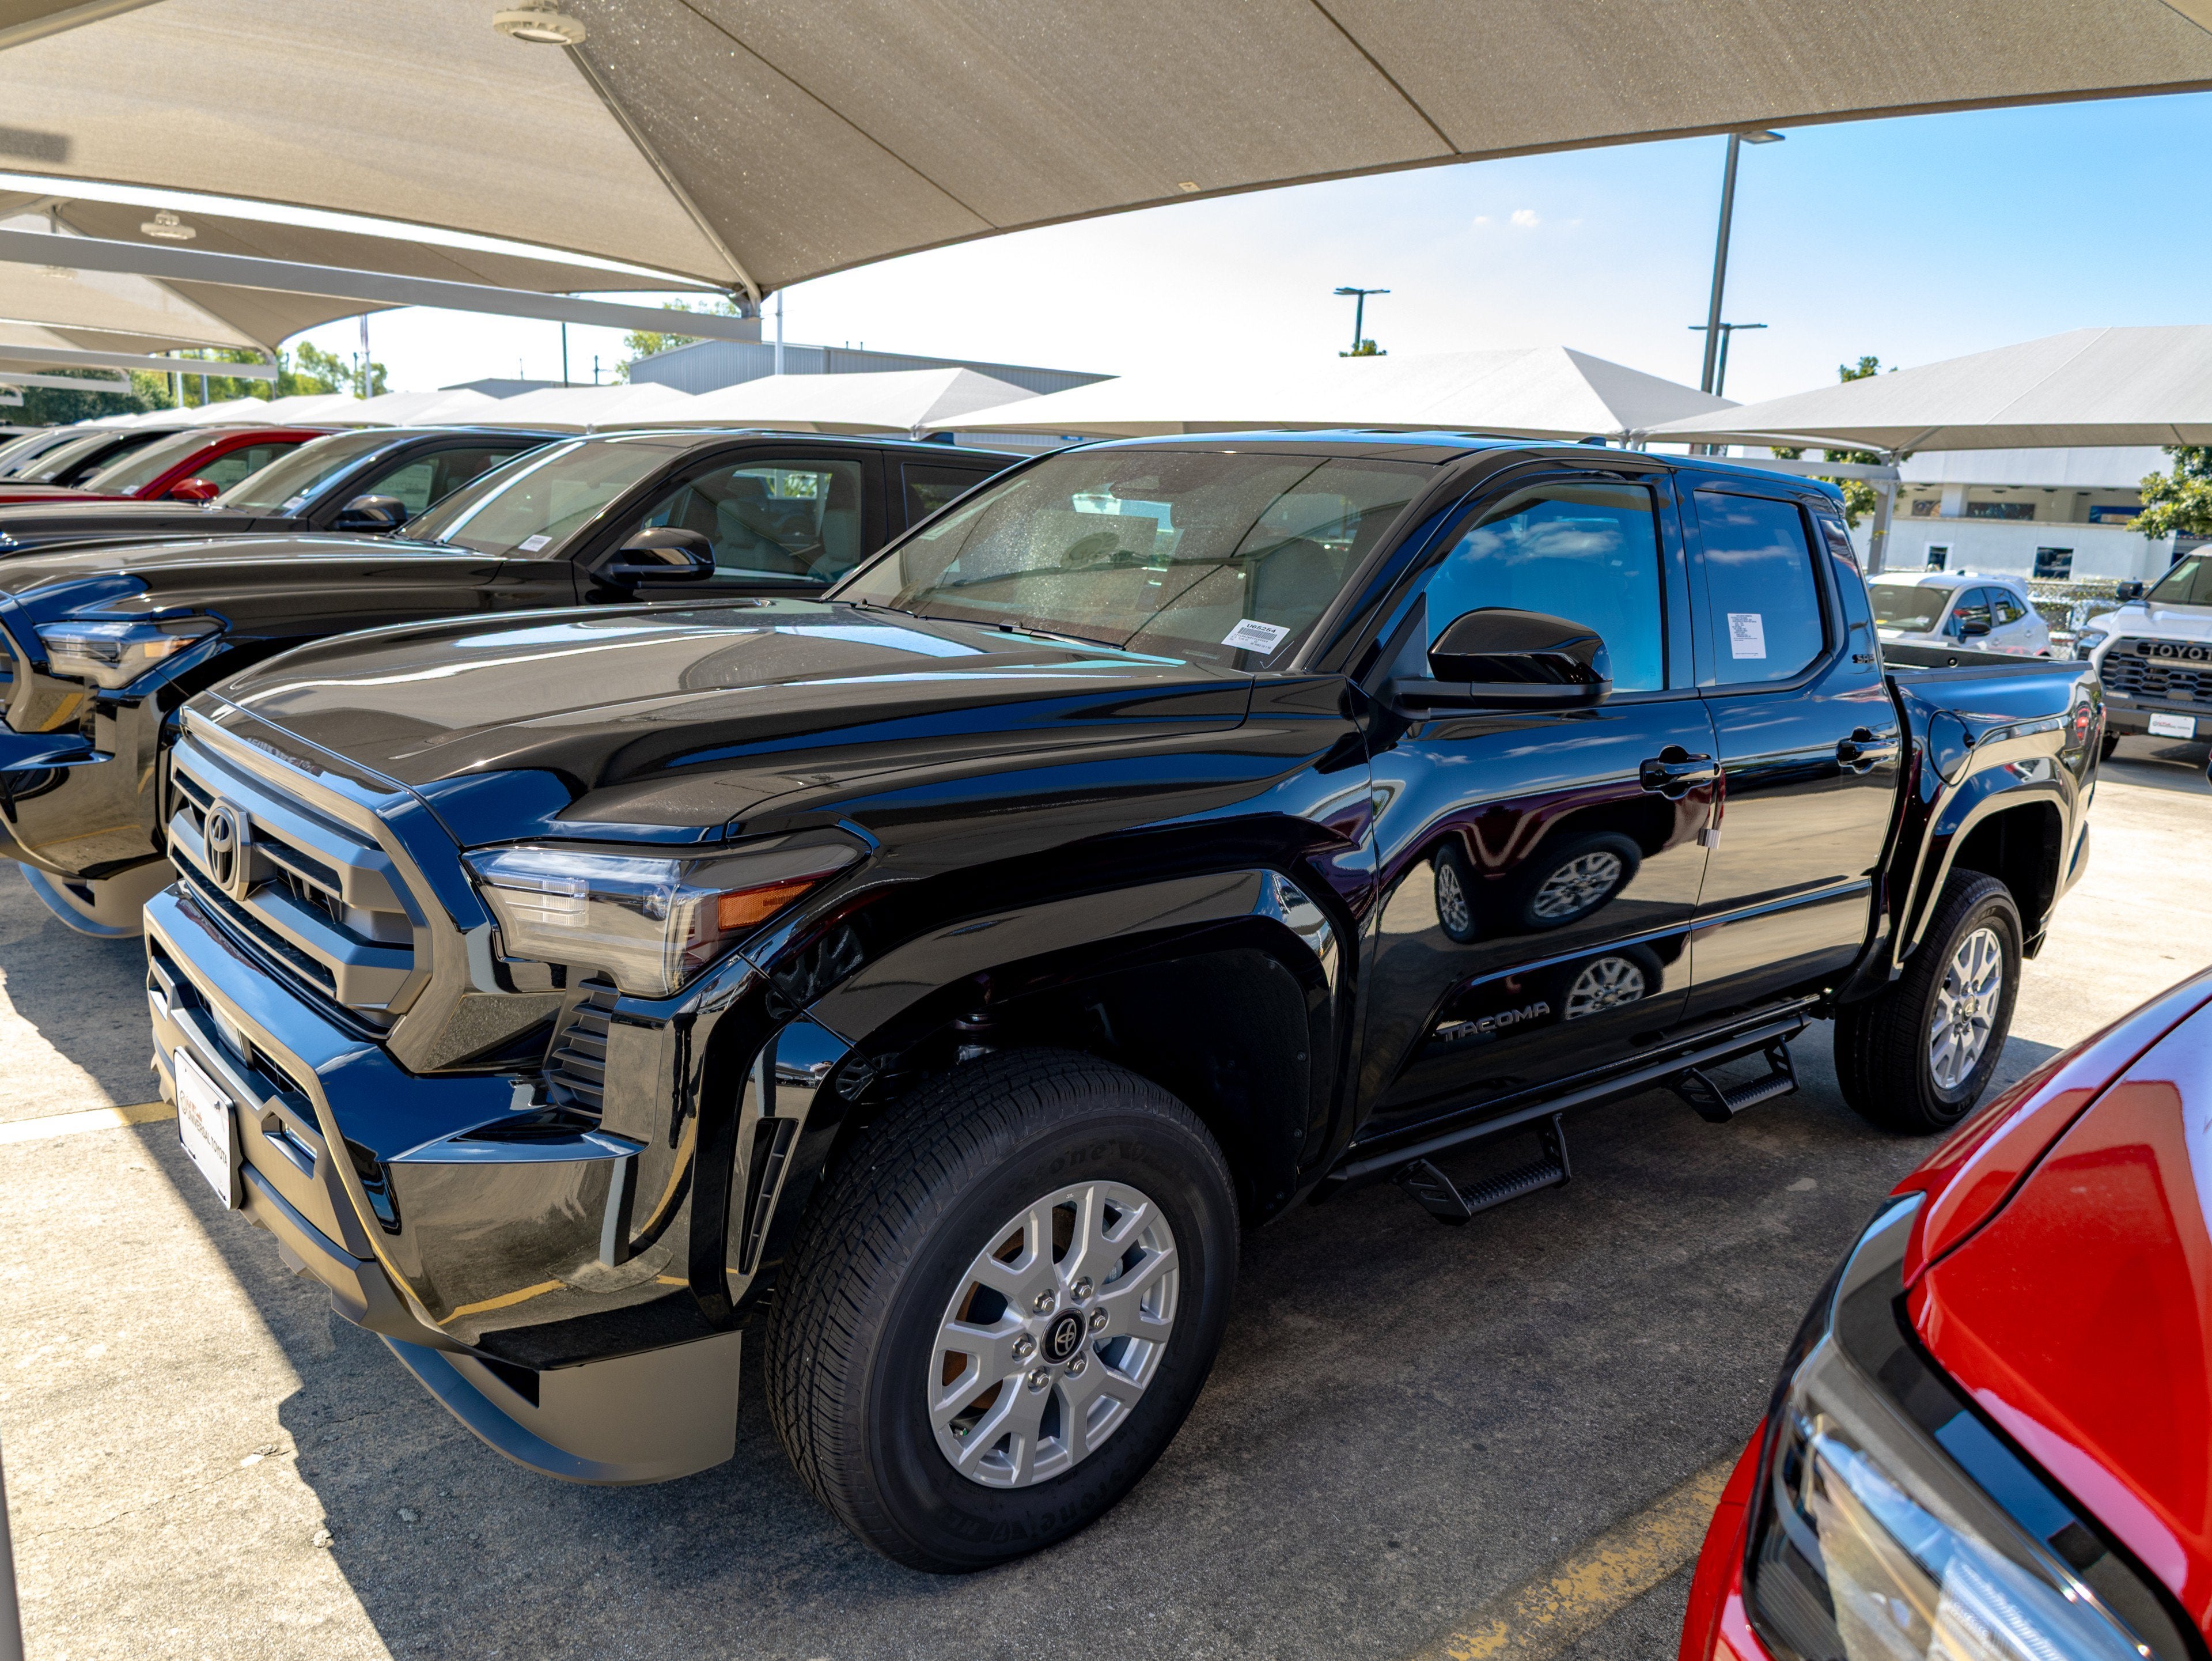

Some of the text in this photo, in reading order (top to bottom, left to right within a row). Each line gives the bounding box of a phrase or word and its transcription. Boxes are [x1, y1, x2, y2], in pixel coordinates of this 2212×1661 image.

[1247, 623, 1277, 633] U65254
[1436, 1001, 1550, 1042] TACOMA
[188, 1110, 210, 1145] UNIVERSAL
[210, 1136, 228, 1168] TOYOTA
